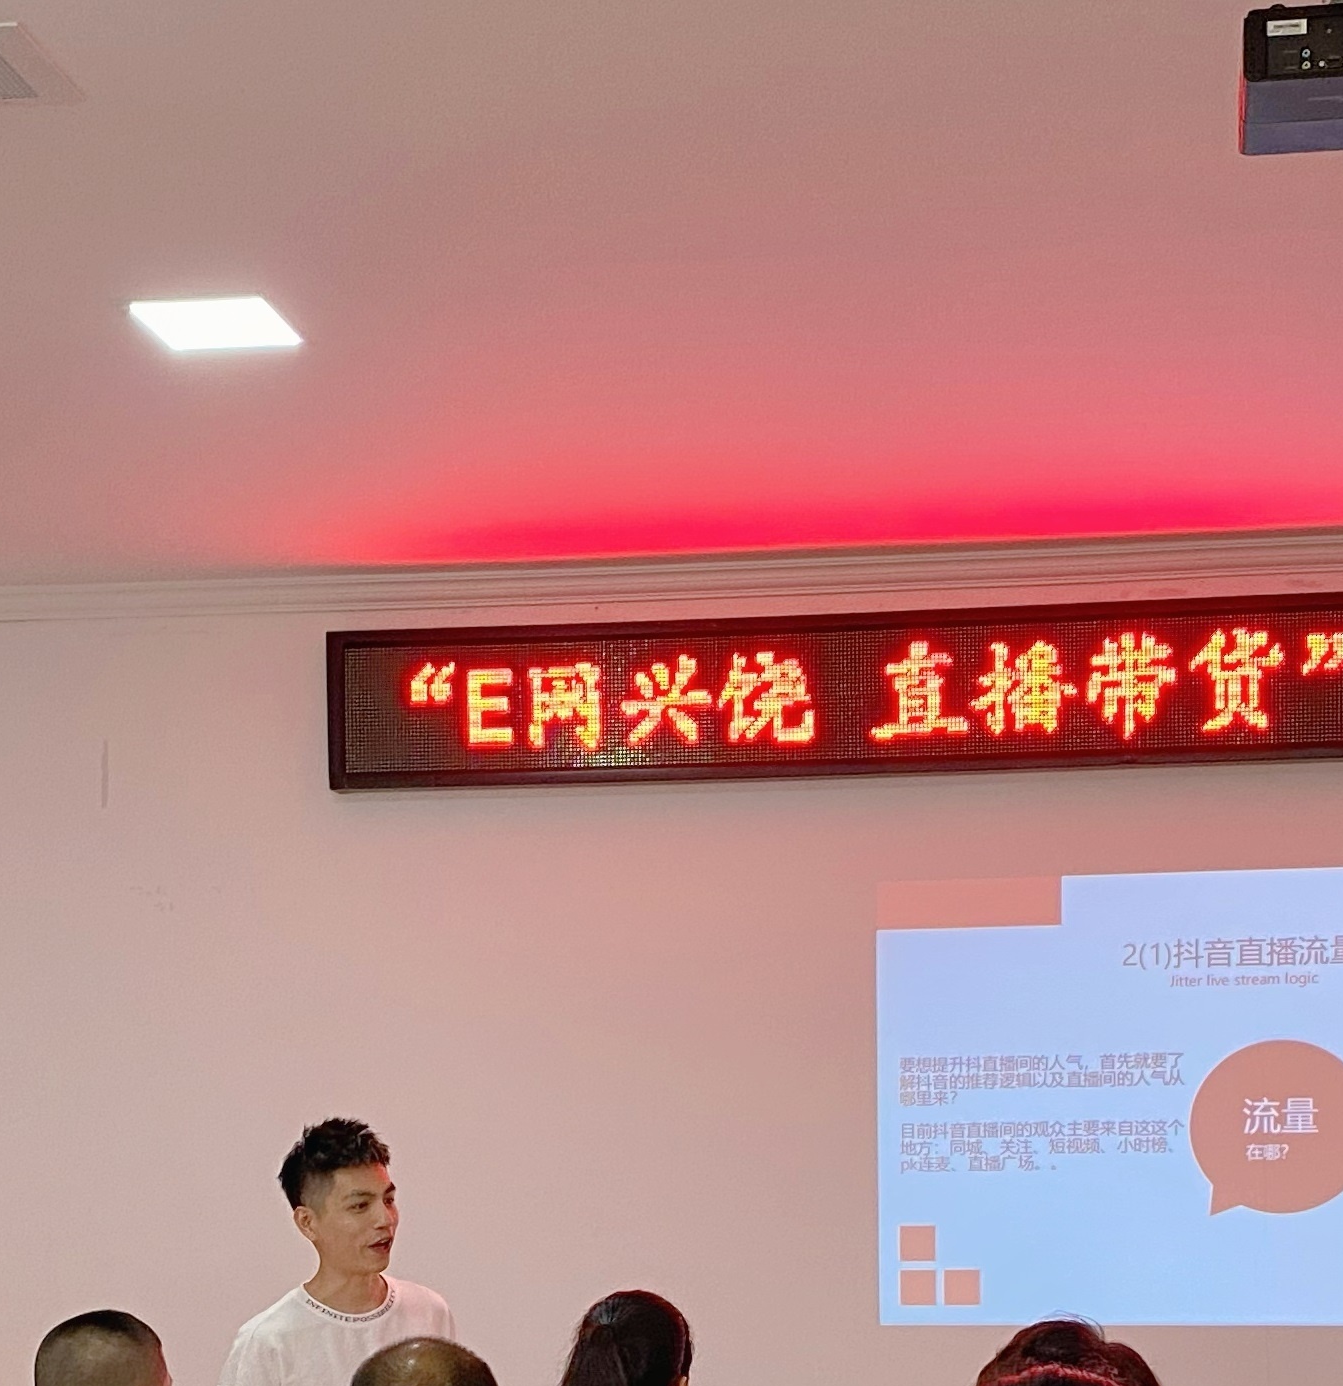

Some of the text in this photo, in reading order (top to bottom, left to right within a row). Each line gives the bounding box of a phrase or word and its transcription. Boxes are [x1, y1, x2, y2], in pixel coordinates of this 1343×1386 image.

[410, 651, 816, 750] “E网兴饶
[1169, 971, 1319, 988] Jitter live stream logic
[1242, 1097, 1319, 1135] 流量
